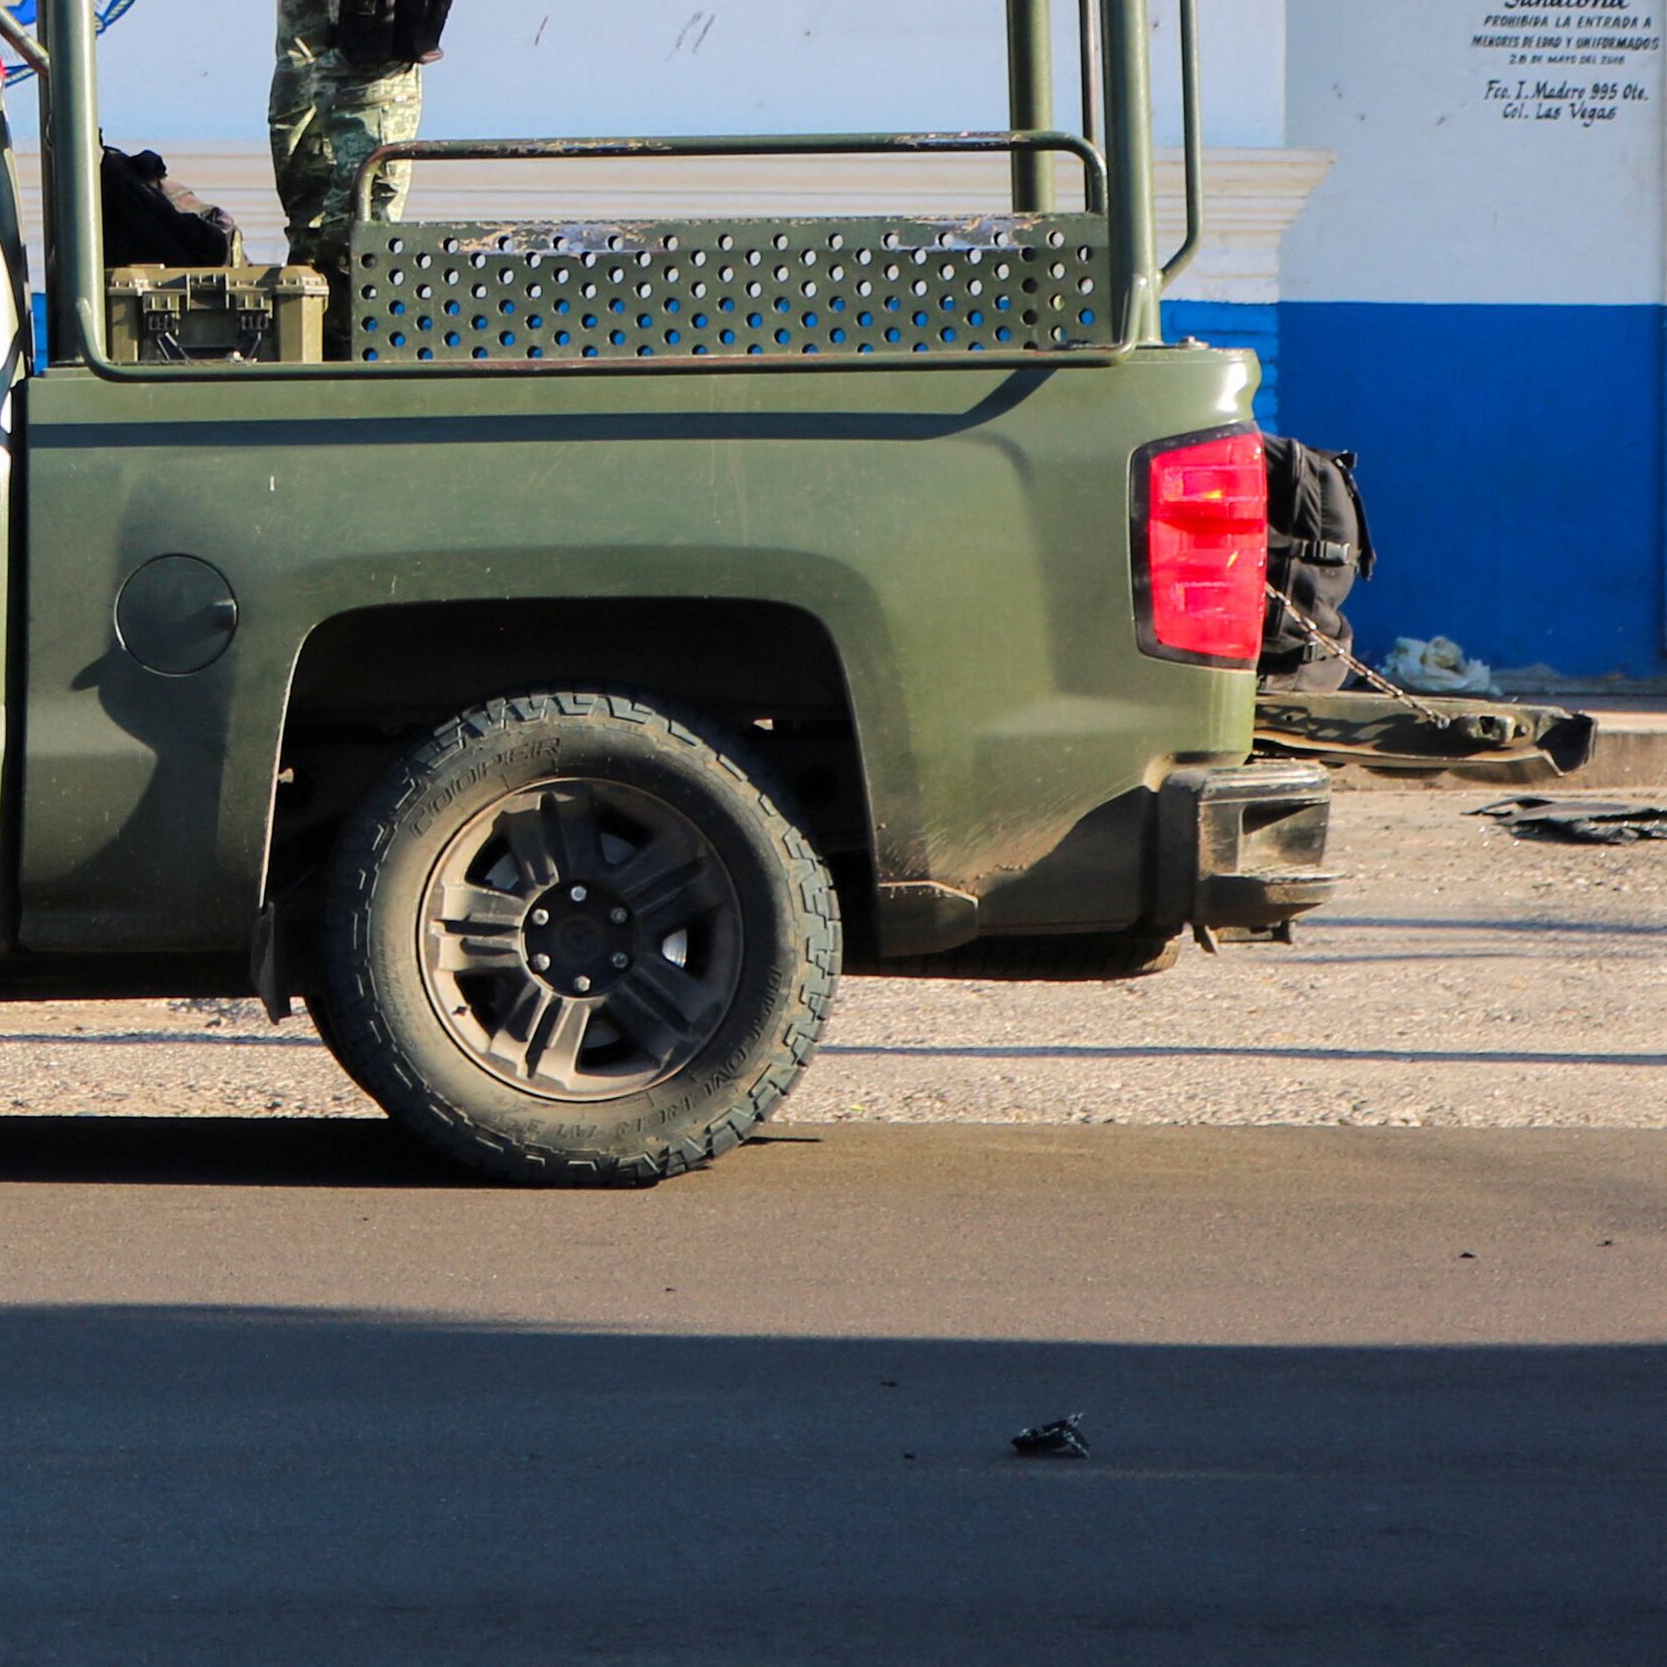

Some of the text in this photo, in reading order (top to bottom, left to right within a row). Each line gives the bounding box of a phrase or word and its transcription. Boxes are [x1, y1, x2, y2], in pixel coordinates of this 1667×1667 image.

[1483, 15, 1652, 29] PROHIBIDA LA ENTRADA A
[1531, 80, 1587, 100] Madero
[1589, 82, 1619, 101] 995
[1502, 101, 1618, 128] Col. Las Vegas
